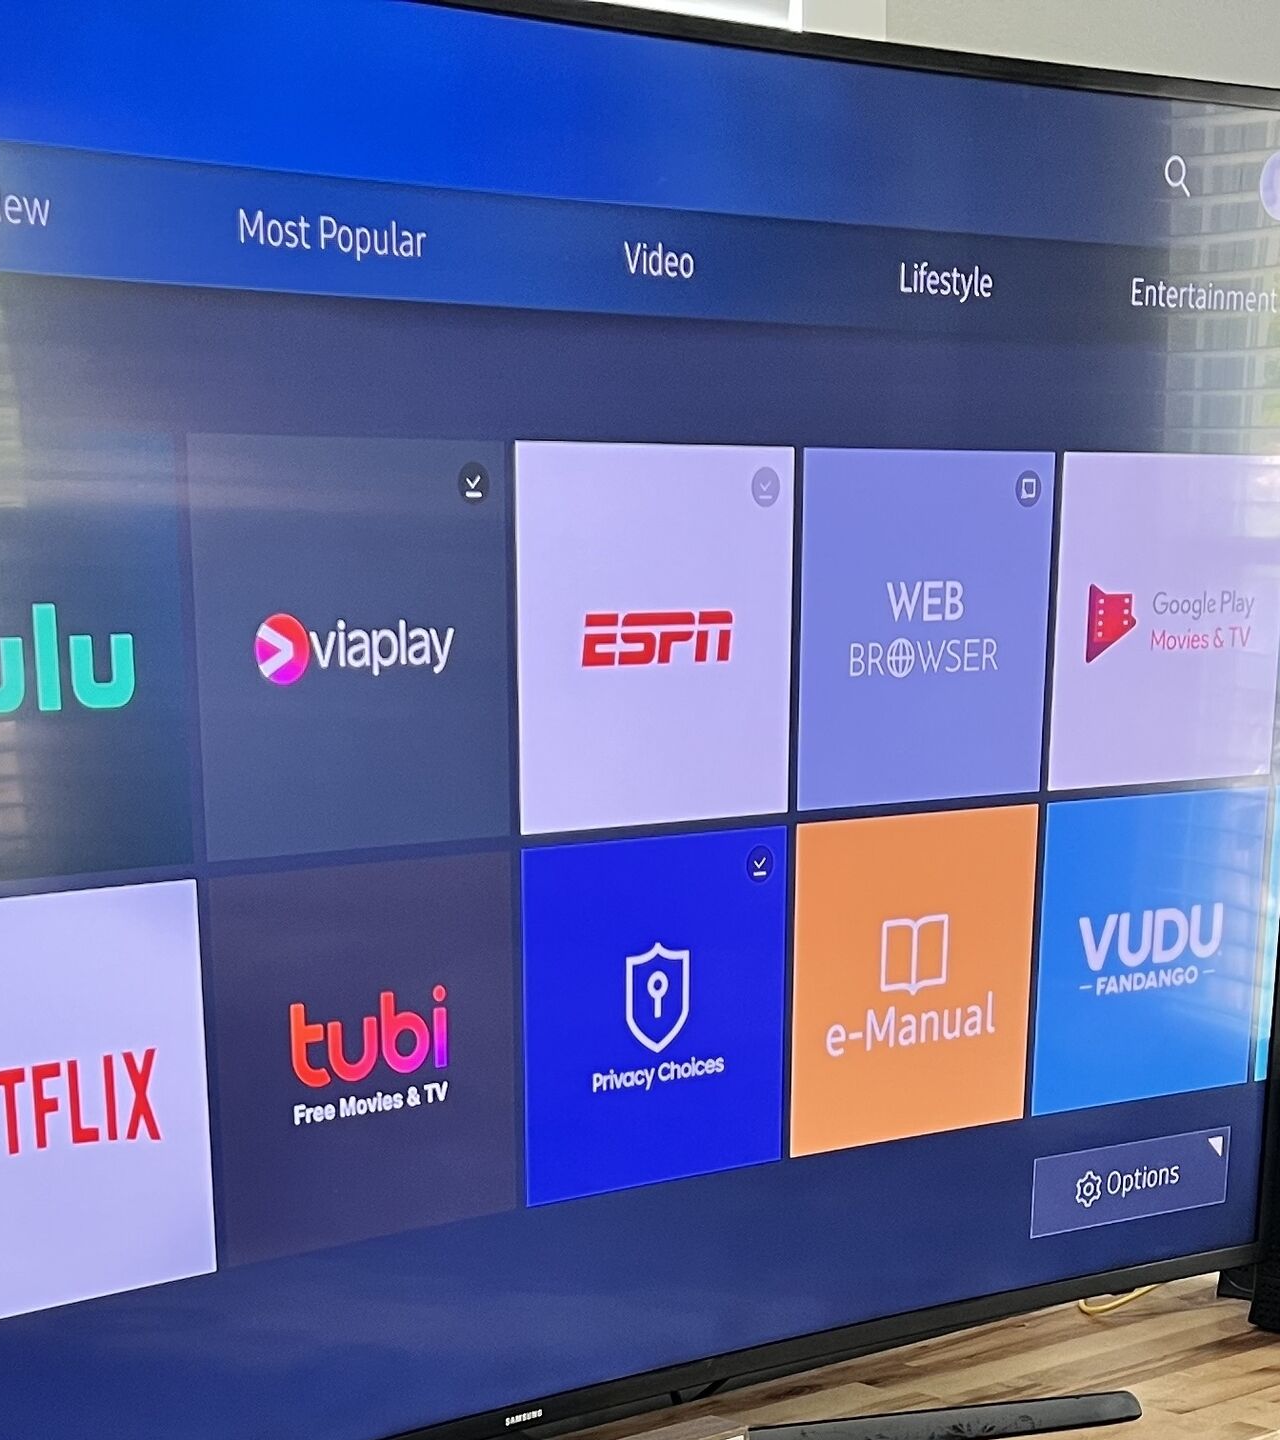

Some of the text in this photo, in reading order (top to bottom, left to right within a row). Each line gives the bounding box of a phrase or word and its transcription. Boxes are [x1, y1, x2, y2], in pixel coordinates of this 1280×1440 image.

[237, 207, 428, 262] Most Popular
[623, 240, 696, 279] Video
[899, 261, 994, 303] Lifestyle
[1130, 277, 1278, 314] Entertainment
[886, 580, 966, 623] WEB
[1152, 589, 1255, 621] Google Play
[308, 618, 456, 677] viaplay
[581, 610, 734, 668] ESPN
[1150, 625, 1252, 651] Movies & TV
[1078, 902, 1224, 972] VUDU
[289, 984, 449, 1089] tubi
[825, 990, 996, 1058] e-Manual
[591, 1055, 726, 1094] Privacy Choices
[292, 1080, 450, 1126] Free Movies & TV
[1106, 1165, 1180, 1198] Options
[505, 1408, 543, 1427] SAMSUNG
